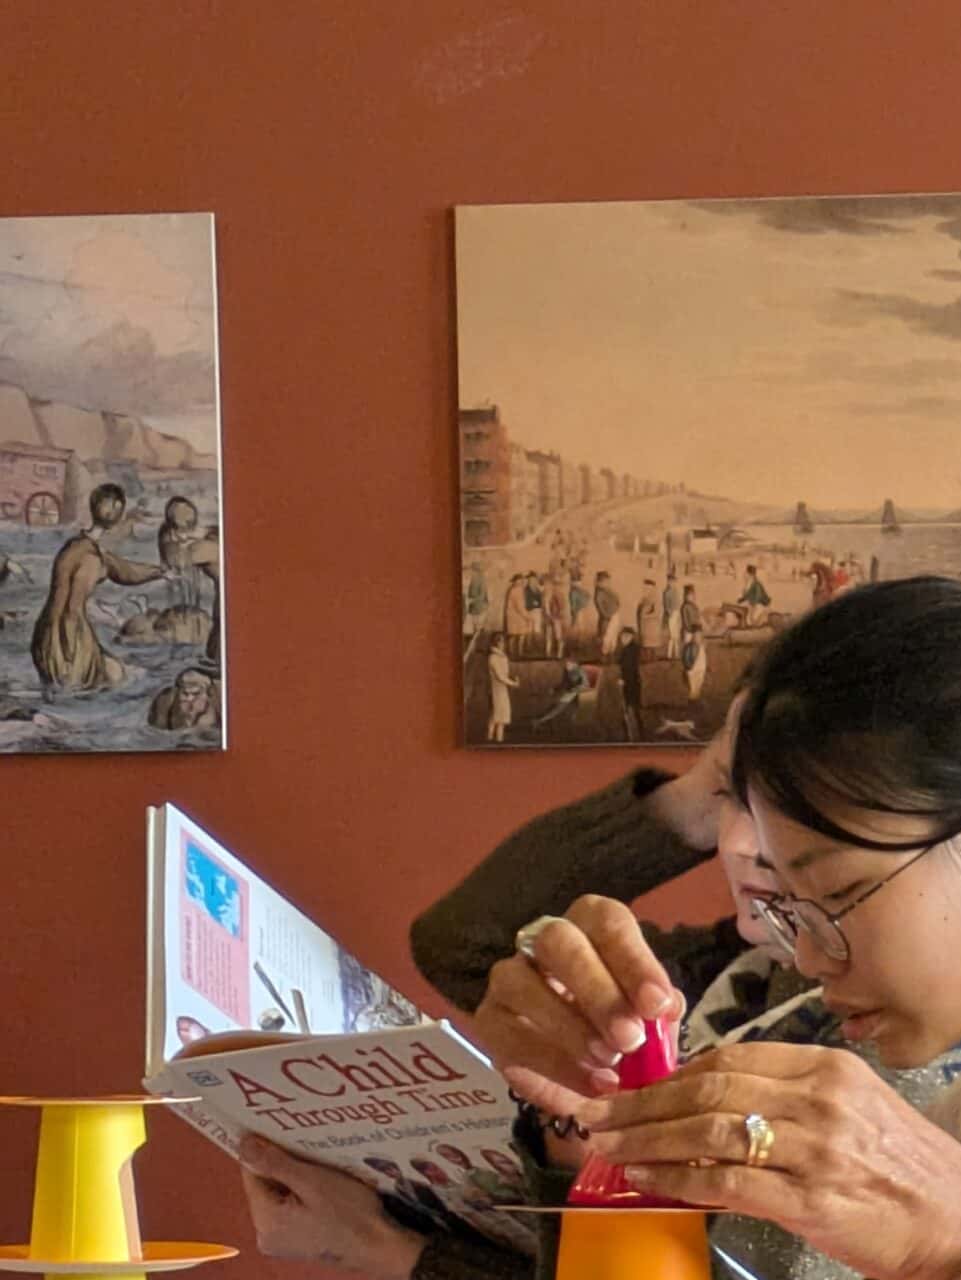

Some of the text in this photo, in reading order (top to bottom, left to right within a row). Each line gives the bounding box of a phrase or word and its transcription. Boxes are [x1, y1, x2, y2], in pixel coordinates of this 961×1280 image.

[226, 1041, 467, 1107] A Child
[255, 1086, 497, 1131] Through Time
